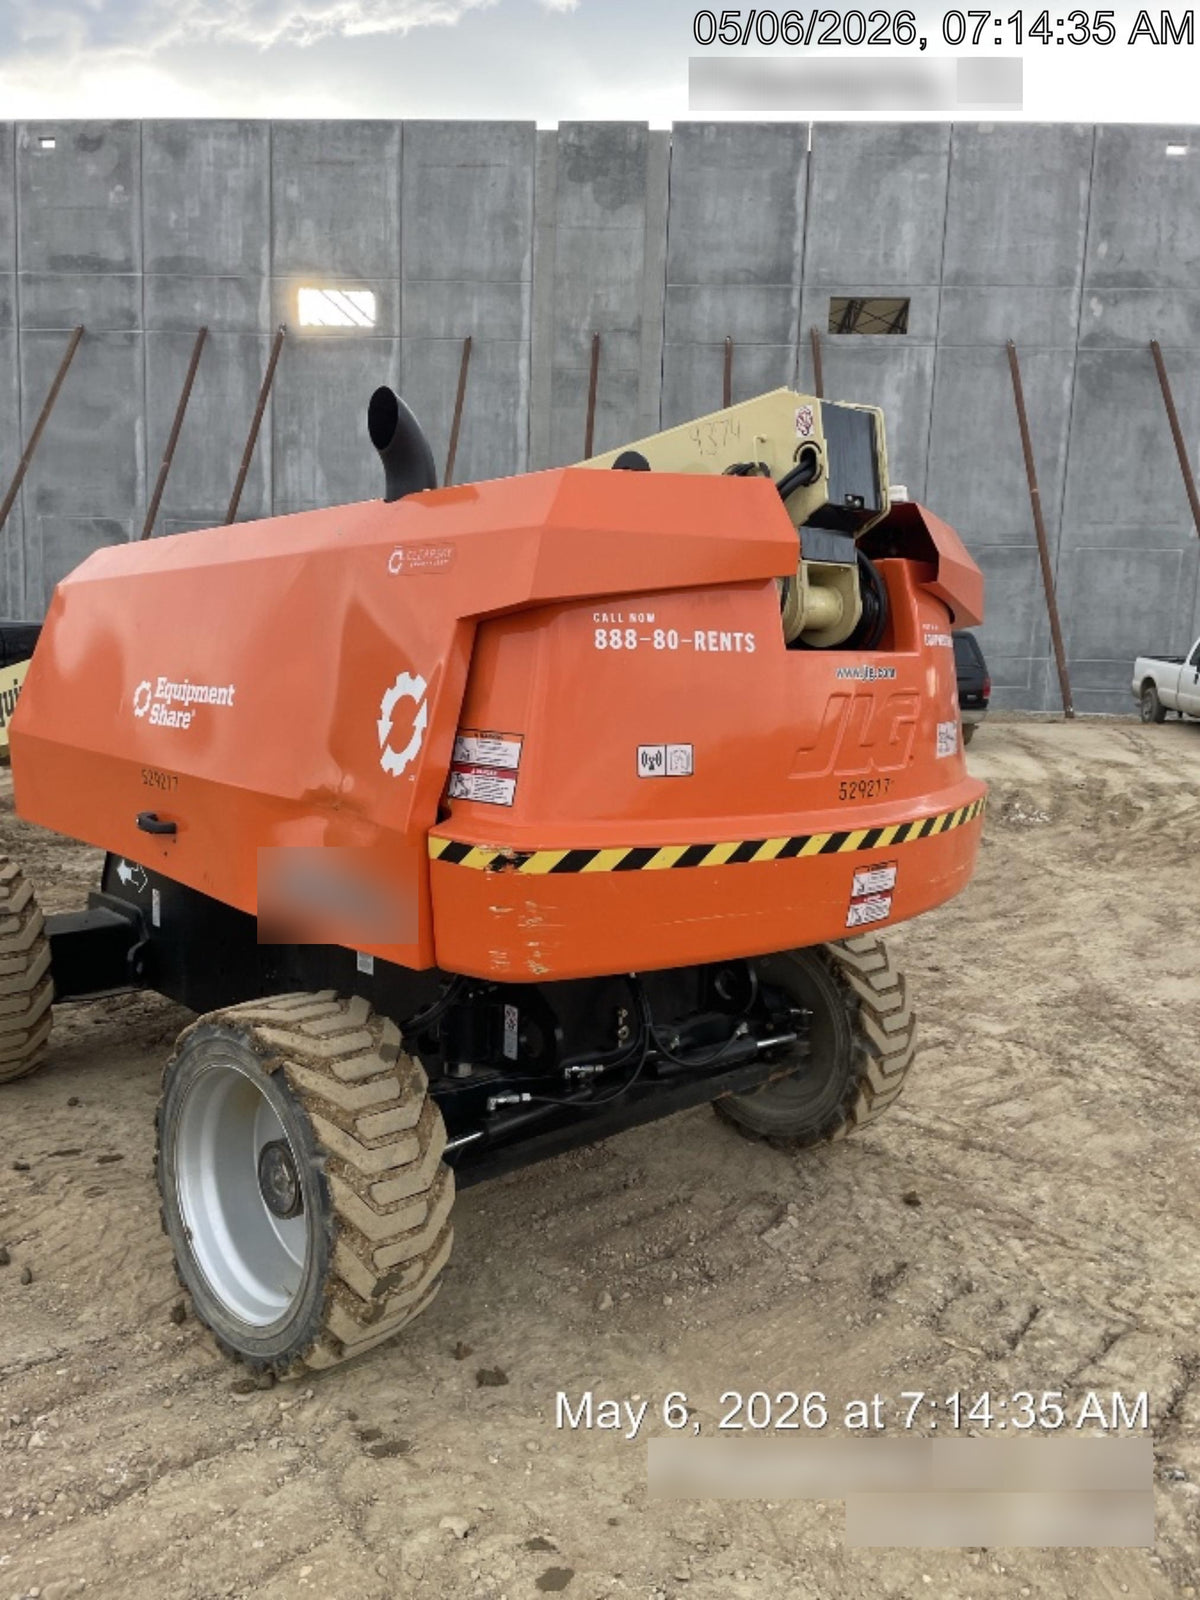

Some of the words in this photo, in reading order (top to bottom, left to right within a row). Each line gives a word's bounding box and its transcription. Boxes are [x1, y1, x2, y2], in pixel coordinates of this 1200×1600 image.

[593, 612, 624, 623] CALL
[629, 613, 656, 623] NOW
[594, 628, 756, 653] 888-80-RENTS
[154, 676, 235, 706] Equipment
[142, 768, 180, 792] 529217
[838, 777, 892, 801] 529217
